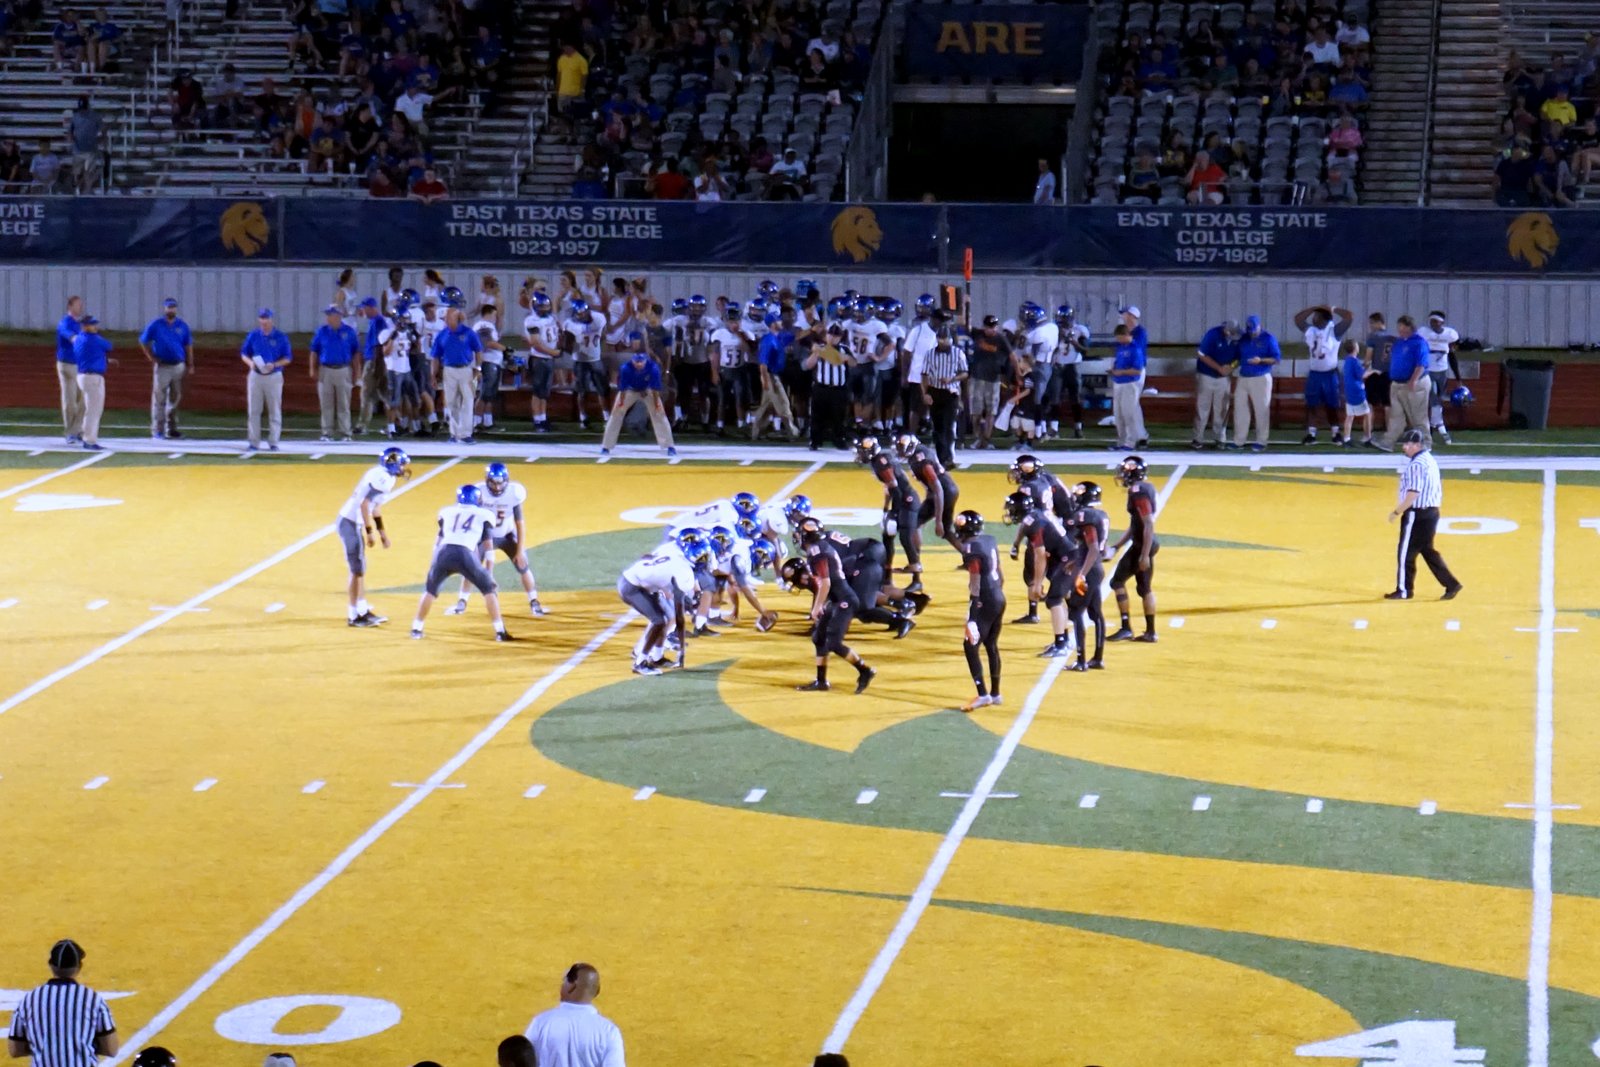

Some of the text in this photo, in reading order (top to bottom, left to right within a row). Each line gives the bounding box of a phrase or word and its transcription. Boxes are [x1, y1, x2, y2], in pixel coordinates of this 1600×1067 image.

[936, 21, 1044, 55] ARE
[452, 205, 657, 221] EAST TEXAS STATE
[1117, 212, 1327, 227] EAST TEXAS STATE
[446, 222, 663, 239] TEACHERS COLLEGE
[1177, 231, 1275, 245] COLLEGE
[509, 241, 600, 255] 1923-1957
[1175, 248, 1268, 263] 1957-1962
[946, 286, 957, 310] 1
[725, 349, 742, 367] 53
[452, 513, 476, 533] 14
[214, 994, 402, 1045] 0
